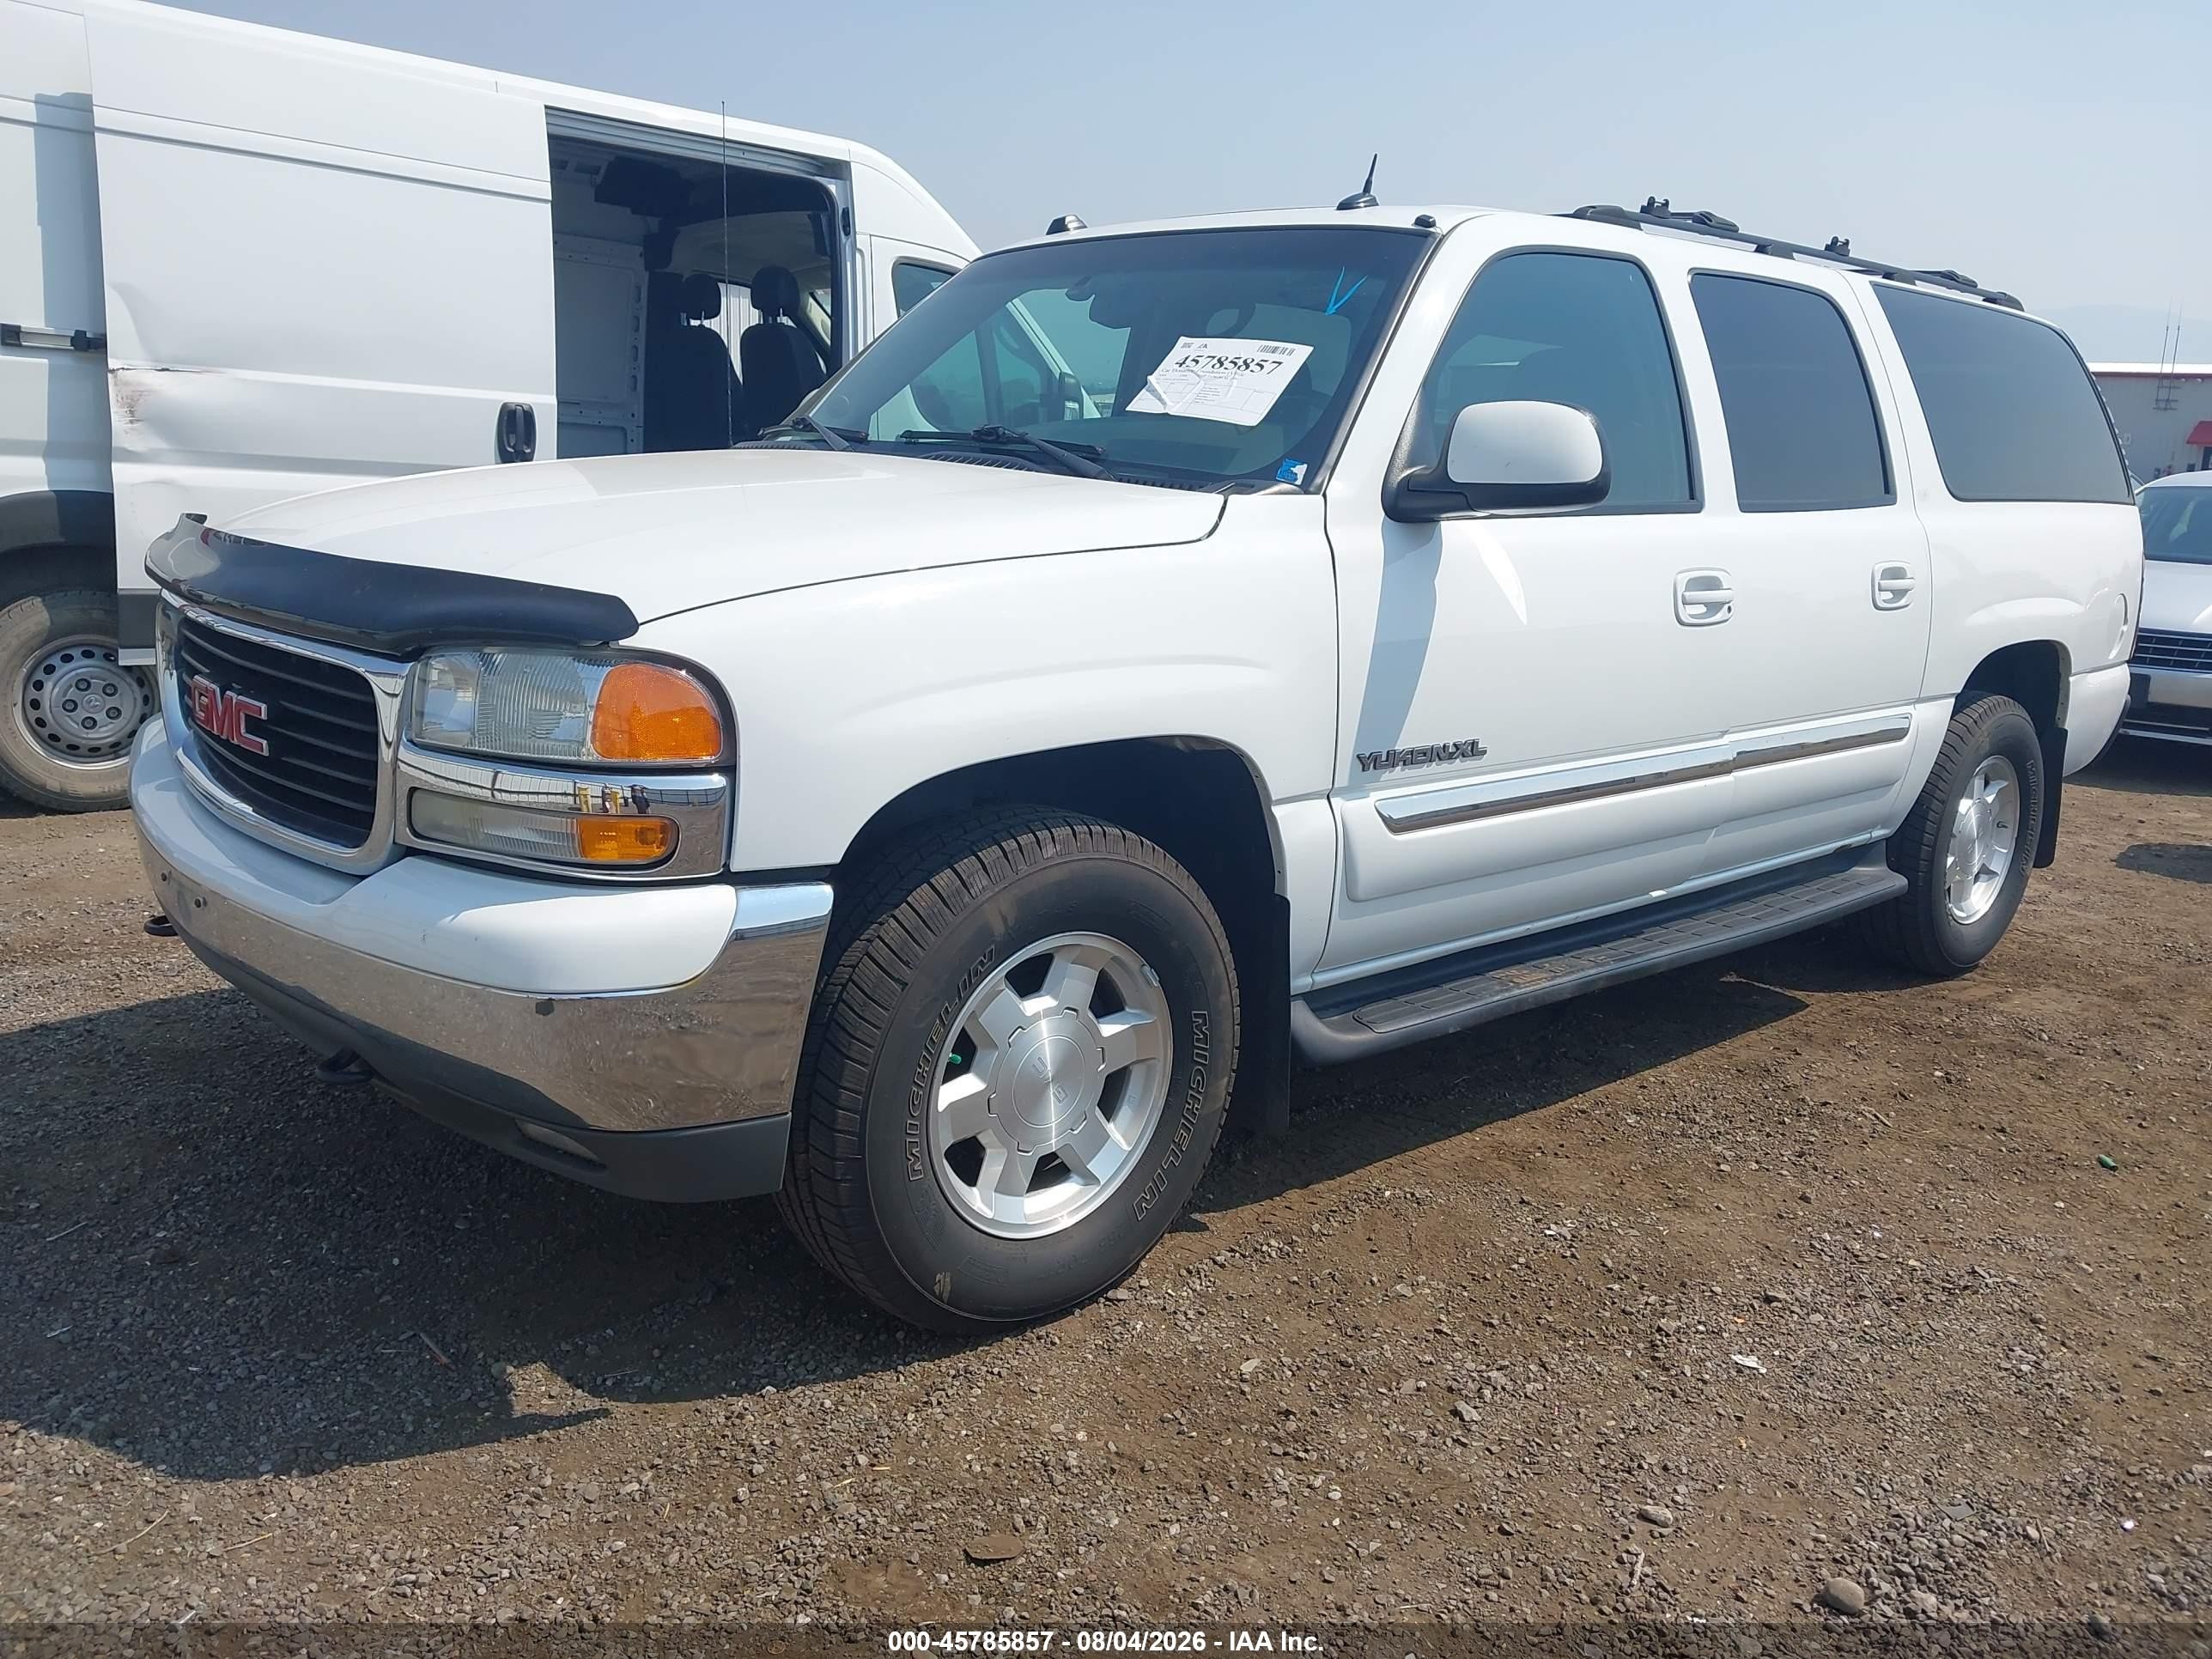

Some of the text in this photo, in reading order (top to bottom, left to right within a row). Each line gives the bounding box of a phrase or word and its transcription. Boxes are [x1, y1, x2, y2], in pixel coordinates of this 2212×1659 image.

[1175, 354, 1284, 376] 45785857
[191, 674, 270, 757] GMC
[1356, 738, 1488, 772] YUKON XL
[905, 946, 996, 1182] MICHELIN
[1133, 1010, 1210, 1222] MICHELIN
